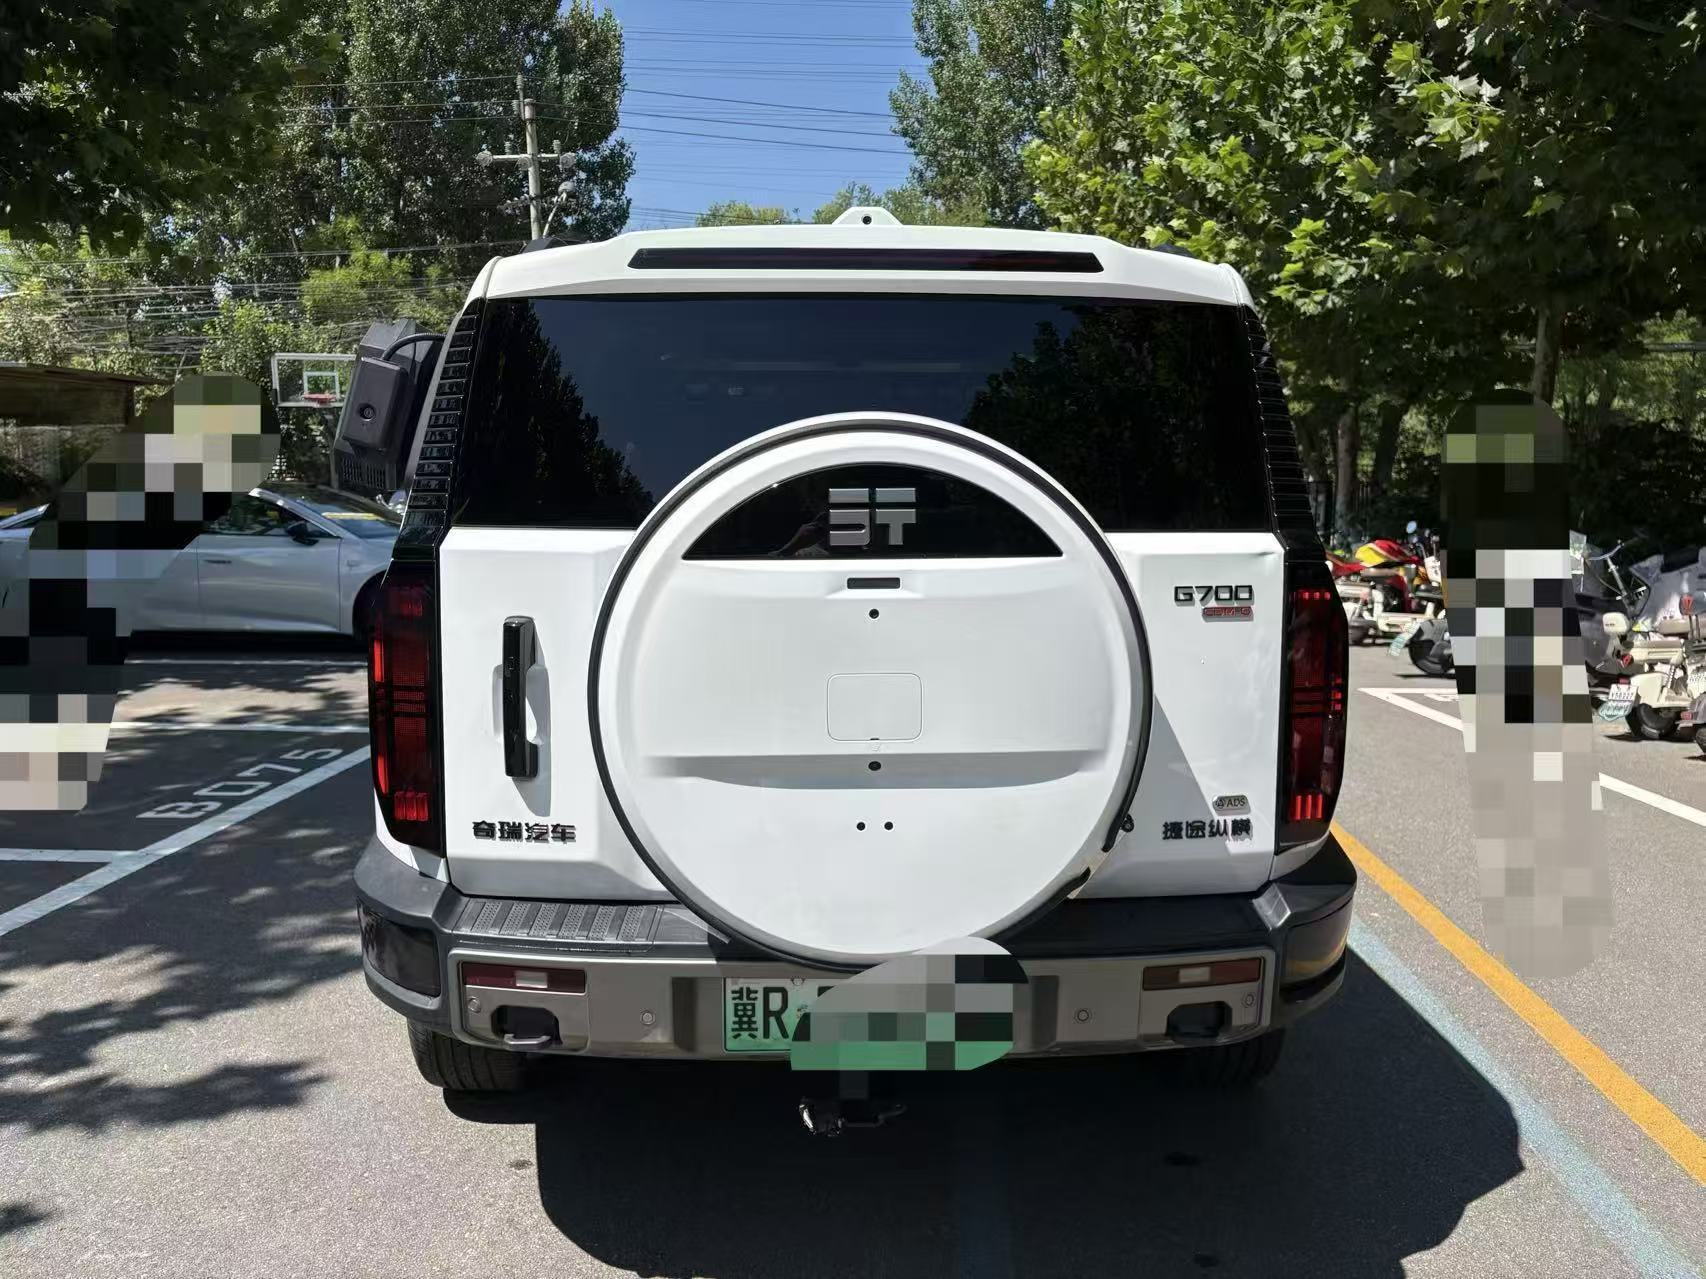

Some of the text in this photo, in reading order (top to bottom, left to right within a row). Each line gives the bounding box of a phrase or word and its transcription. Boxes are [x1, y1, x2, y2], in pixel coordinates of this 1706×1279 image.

[1174, 585, 1253, 602] G700
[136, 748, 344, 819] B075
[1226, 797, 1246, 808] ADS
[472, 820, 576, 842] 奇瑞汽车
[1162, 818, 1252, 840] 捷途纵横
